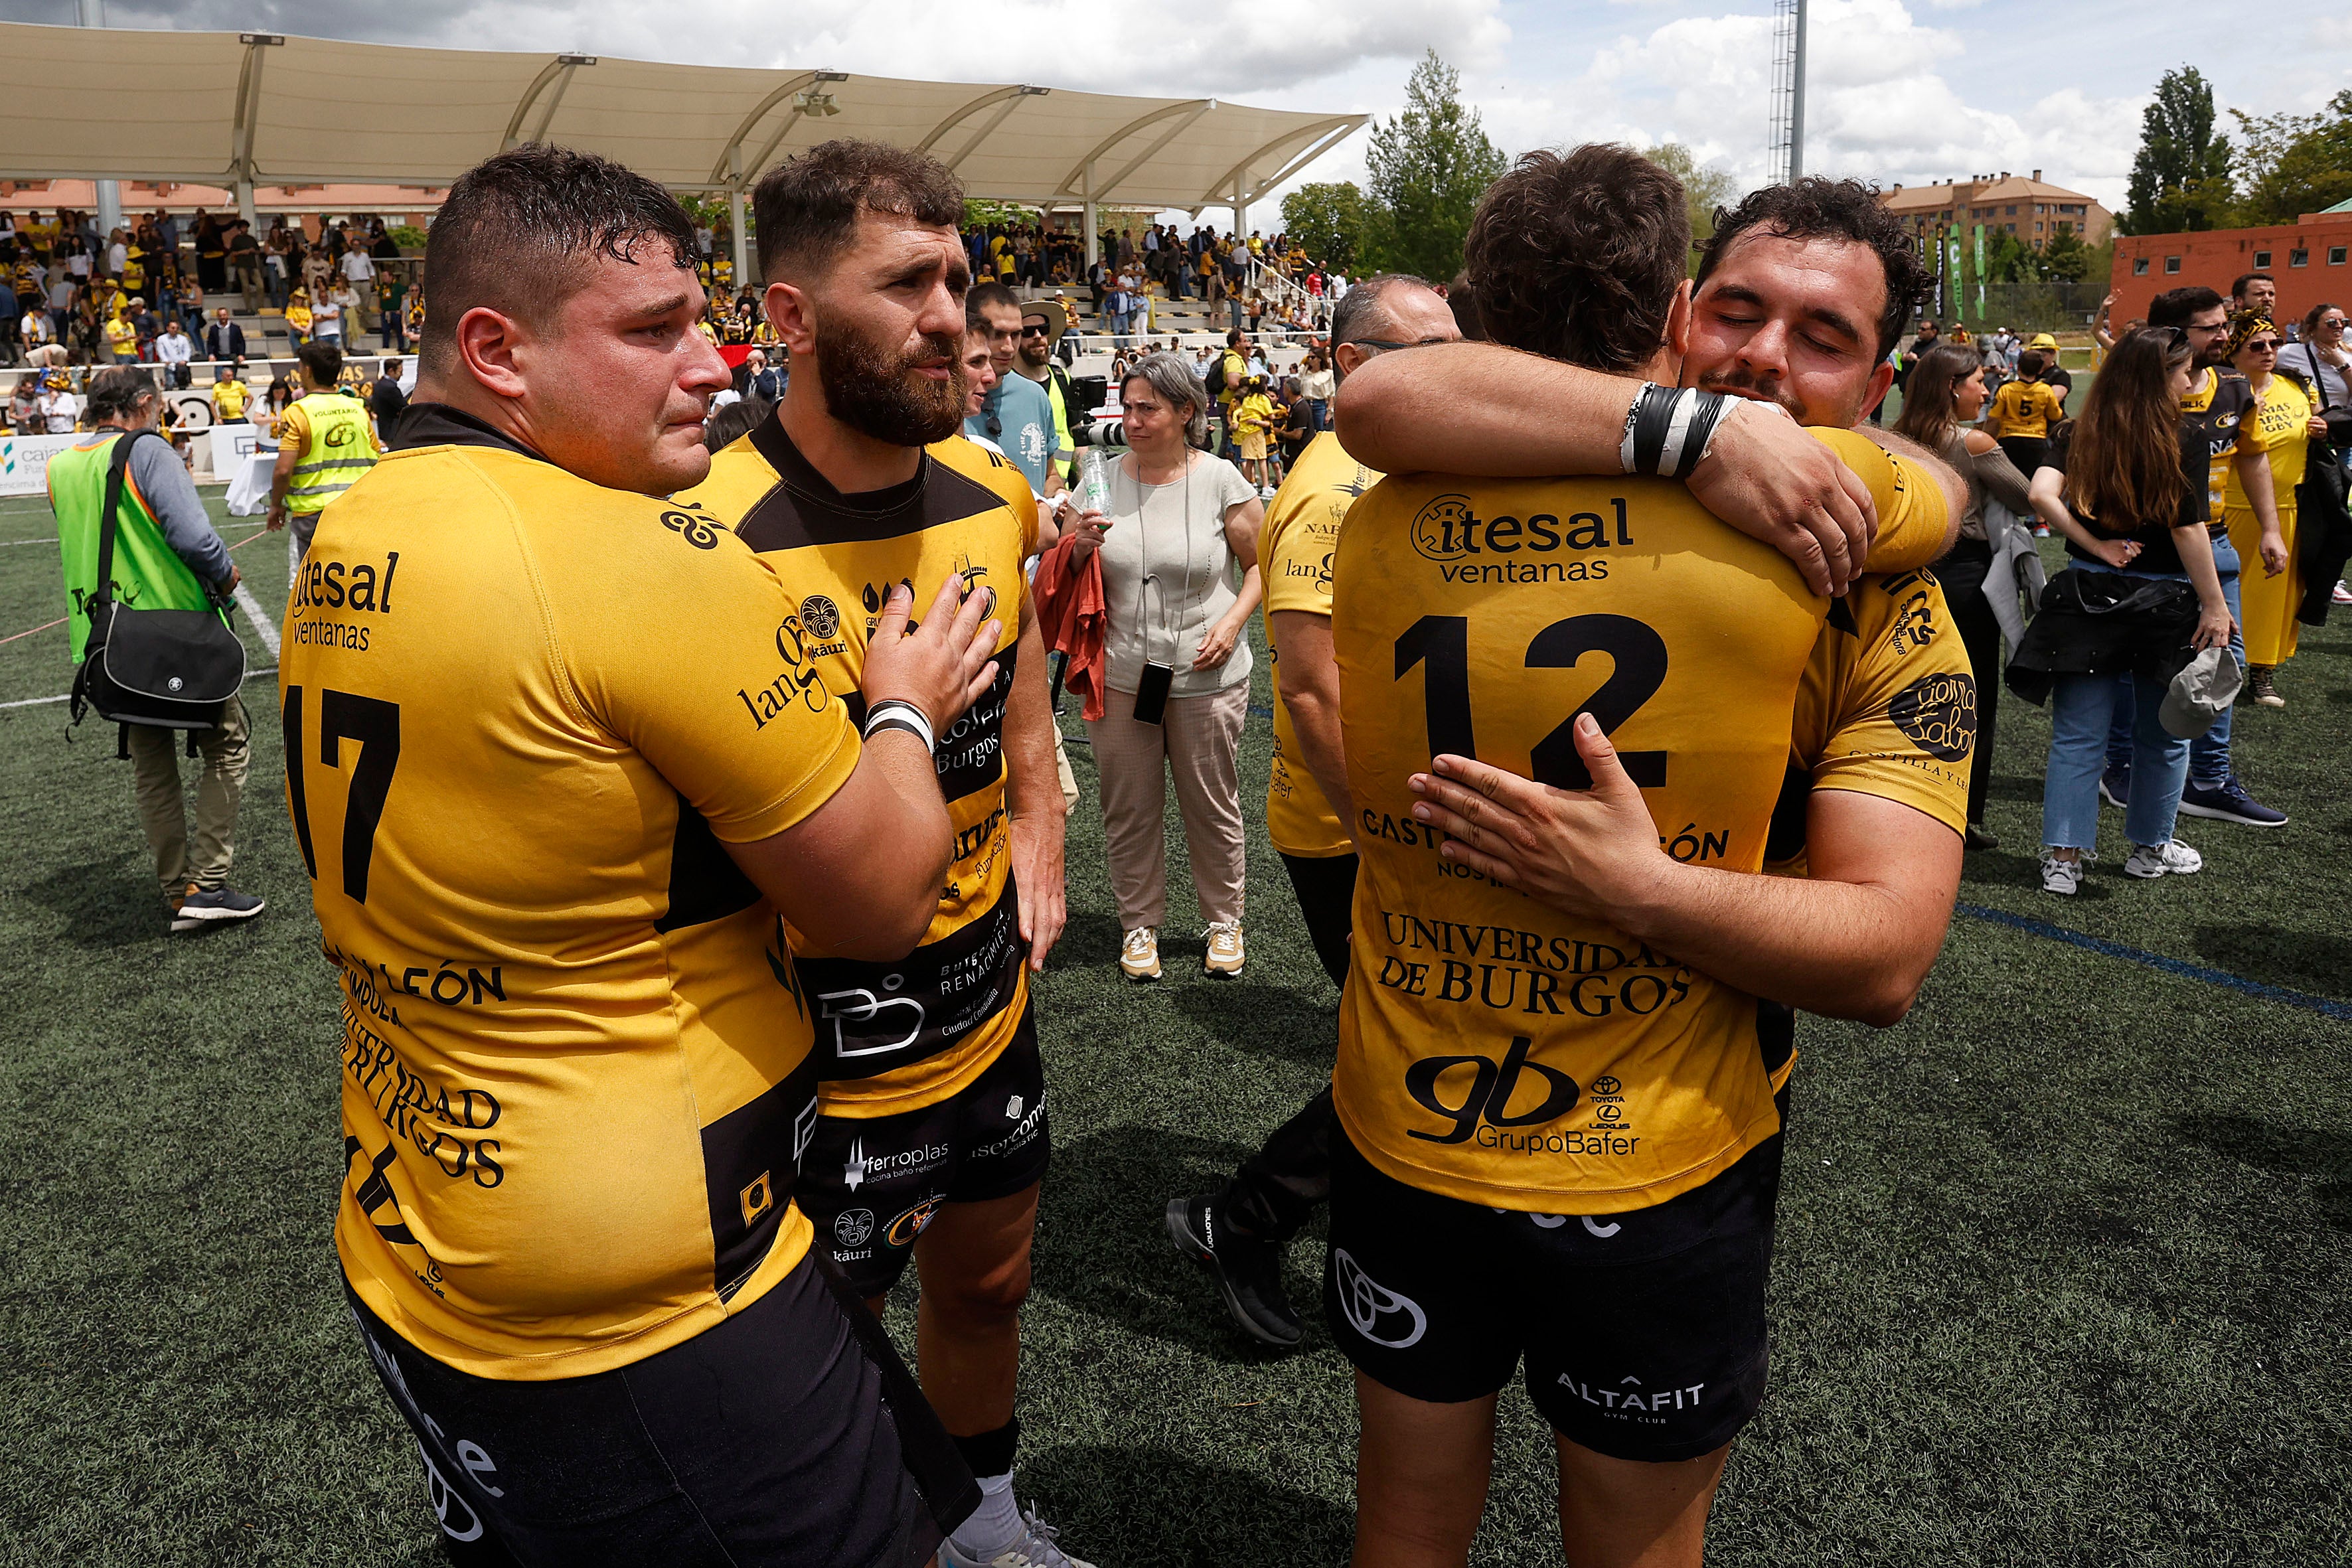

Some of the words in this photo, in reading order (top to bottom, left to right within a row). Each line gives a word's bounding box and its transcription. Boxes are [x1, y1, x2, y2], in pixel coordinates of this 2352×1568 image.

[313, 408, 358, 418] VOLUNTARIO
[2019, 400, 2033, 416] 5
[1441, 497, 1634, 554] itesal
[297, 552, 400, 613] itesal
[1440, 558, 1609, 584] ventanas
[294, 616, 370, 651] ventanas
[1394, 613, 1668, 790] 12
[937, 733, 998, 774] Burgos
[1946, 771, 1954, 781] Y
[282, 684, 400, 905] 17
[1378, 955, 1429, 996] DE
[1436, 959, 1691, 1017] BURGOS
[942, 1015, 974, 1036] Ciudad
[1405, 1036, 1581, 1144] gb
[1003, 1129, 1038, 1158] LOGISTIC
[1476, 1125, 1640, 1156] GrupoBafer
[866, 1173, 892, 1184] cocina
[894, 1168, 913, 1178] baño
[915, 1158, 947, 1174] reformas
[868, 1143, 948, 1174] ferroplas
[833, 1247, 872, 1262] kāuri
[1604, 1412, 1628, 1421] GYM
